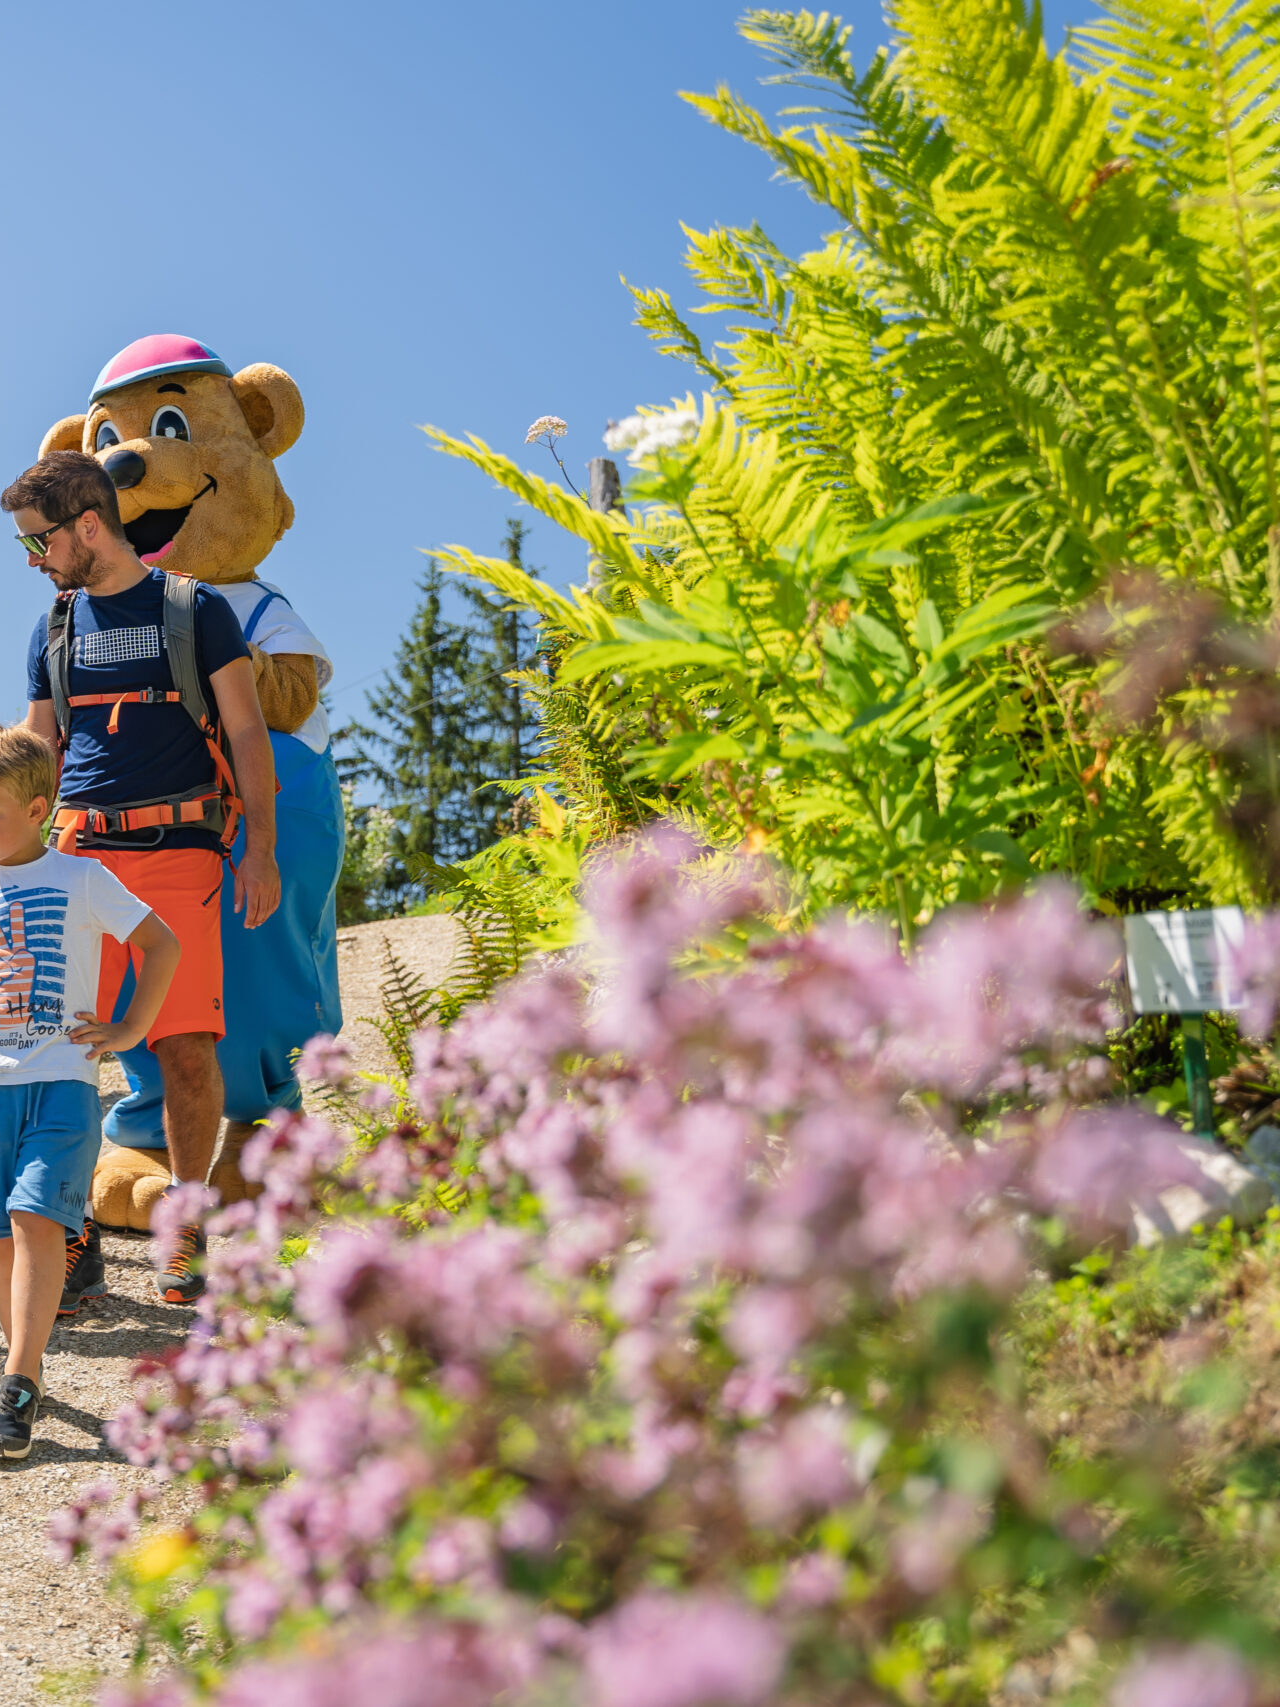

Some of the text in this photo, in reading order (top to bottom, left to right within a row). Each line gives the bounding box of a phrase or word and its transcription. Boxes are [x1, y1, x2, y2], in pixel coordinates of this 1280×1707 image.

[6, 992, 64, 1020] Hang
[26, 1015, 71, 1036] Loose
[0, 1038, 17, 1046] GOOD
